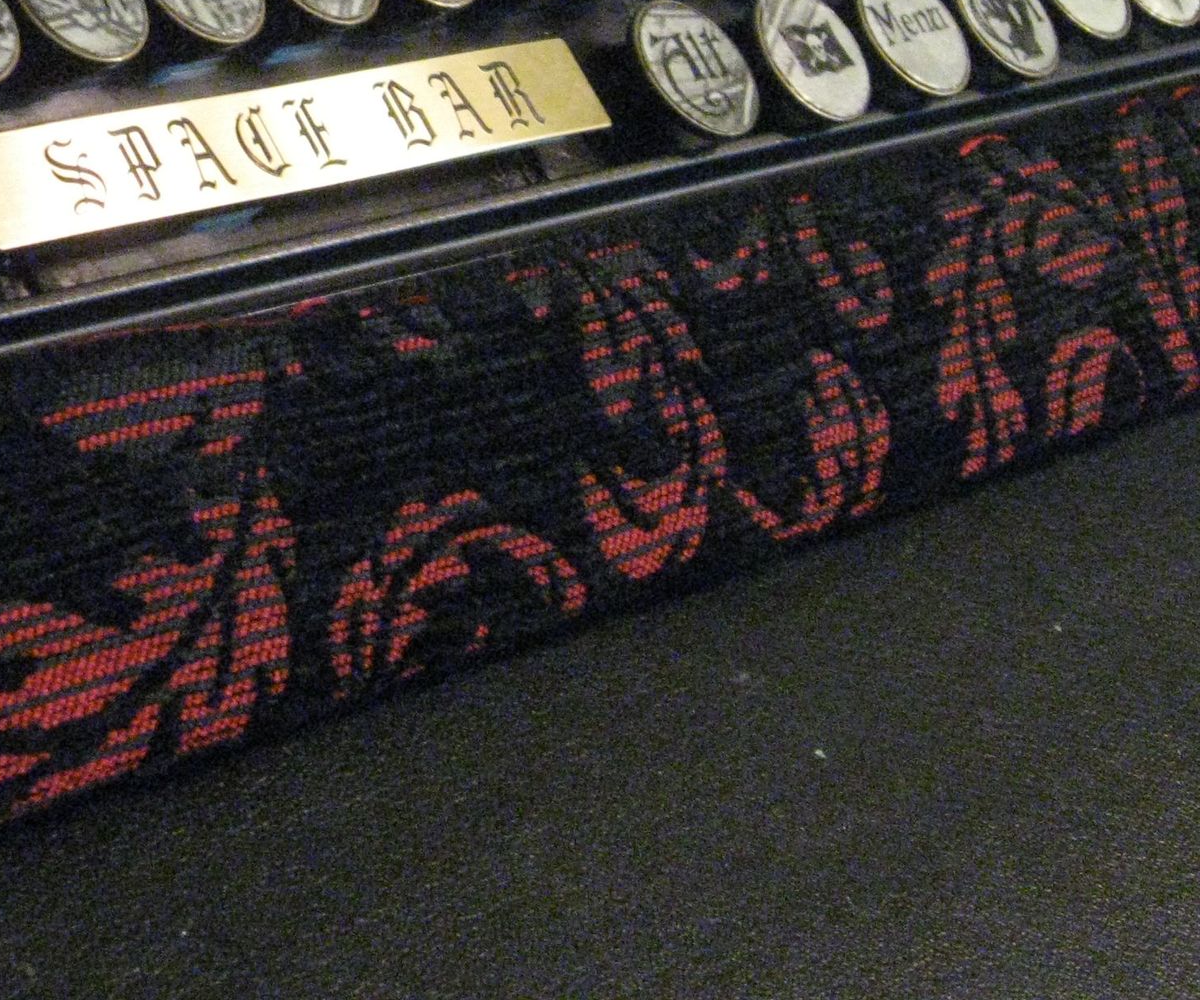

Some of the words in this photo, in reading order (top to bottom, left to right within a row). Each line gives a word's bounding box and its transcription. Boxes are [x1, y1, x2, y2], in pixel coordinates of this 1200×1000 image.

[867, 1, 950, 49] Menu
[648, 27, 733, 118] Alt
[43, 97, 350, 215] SPACE
[372, 60, 547, 149] BAR
